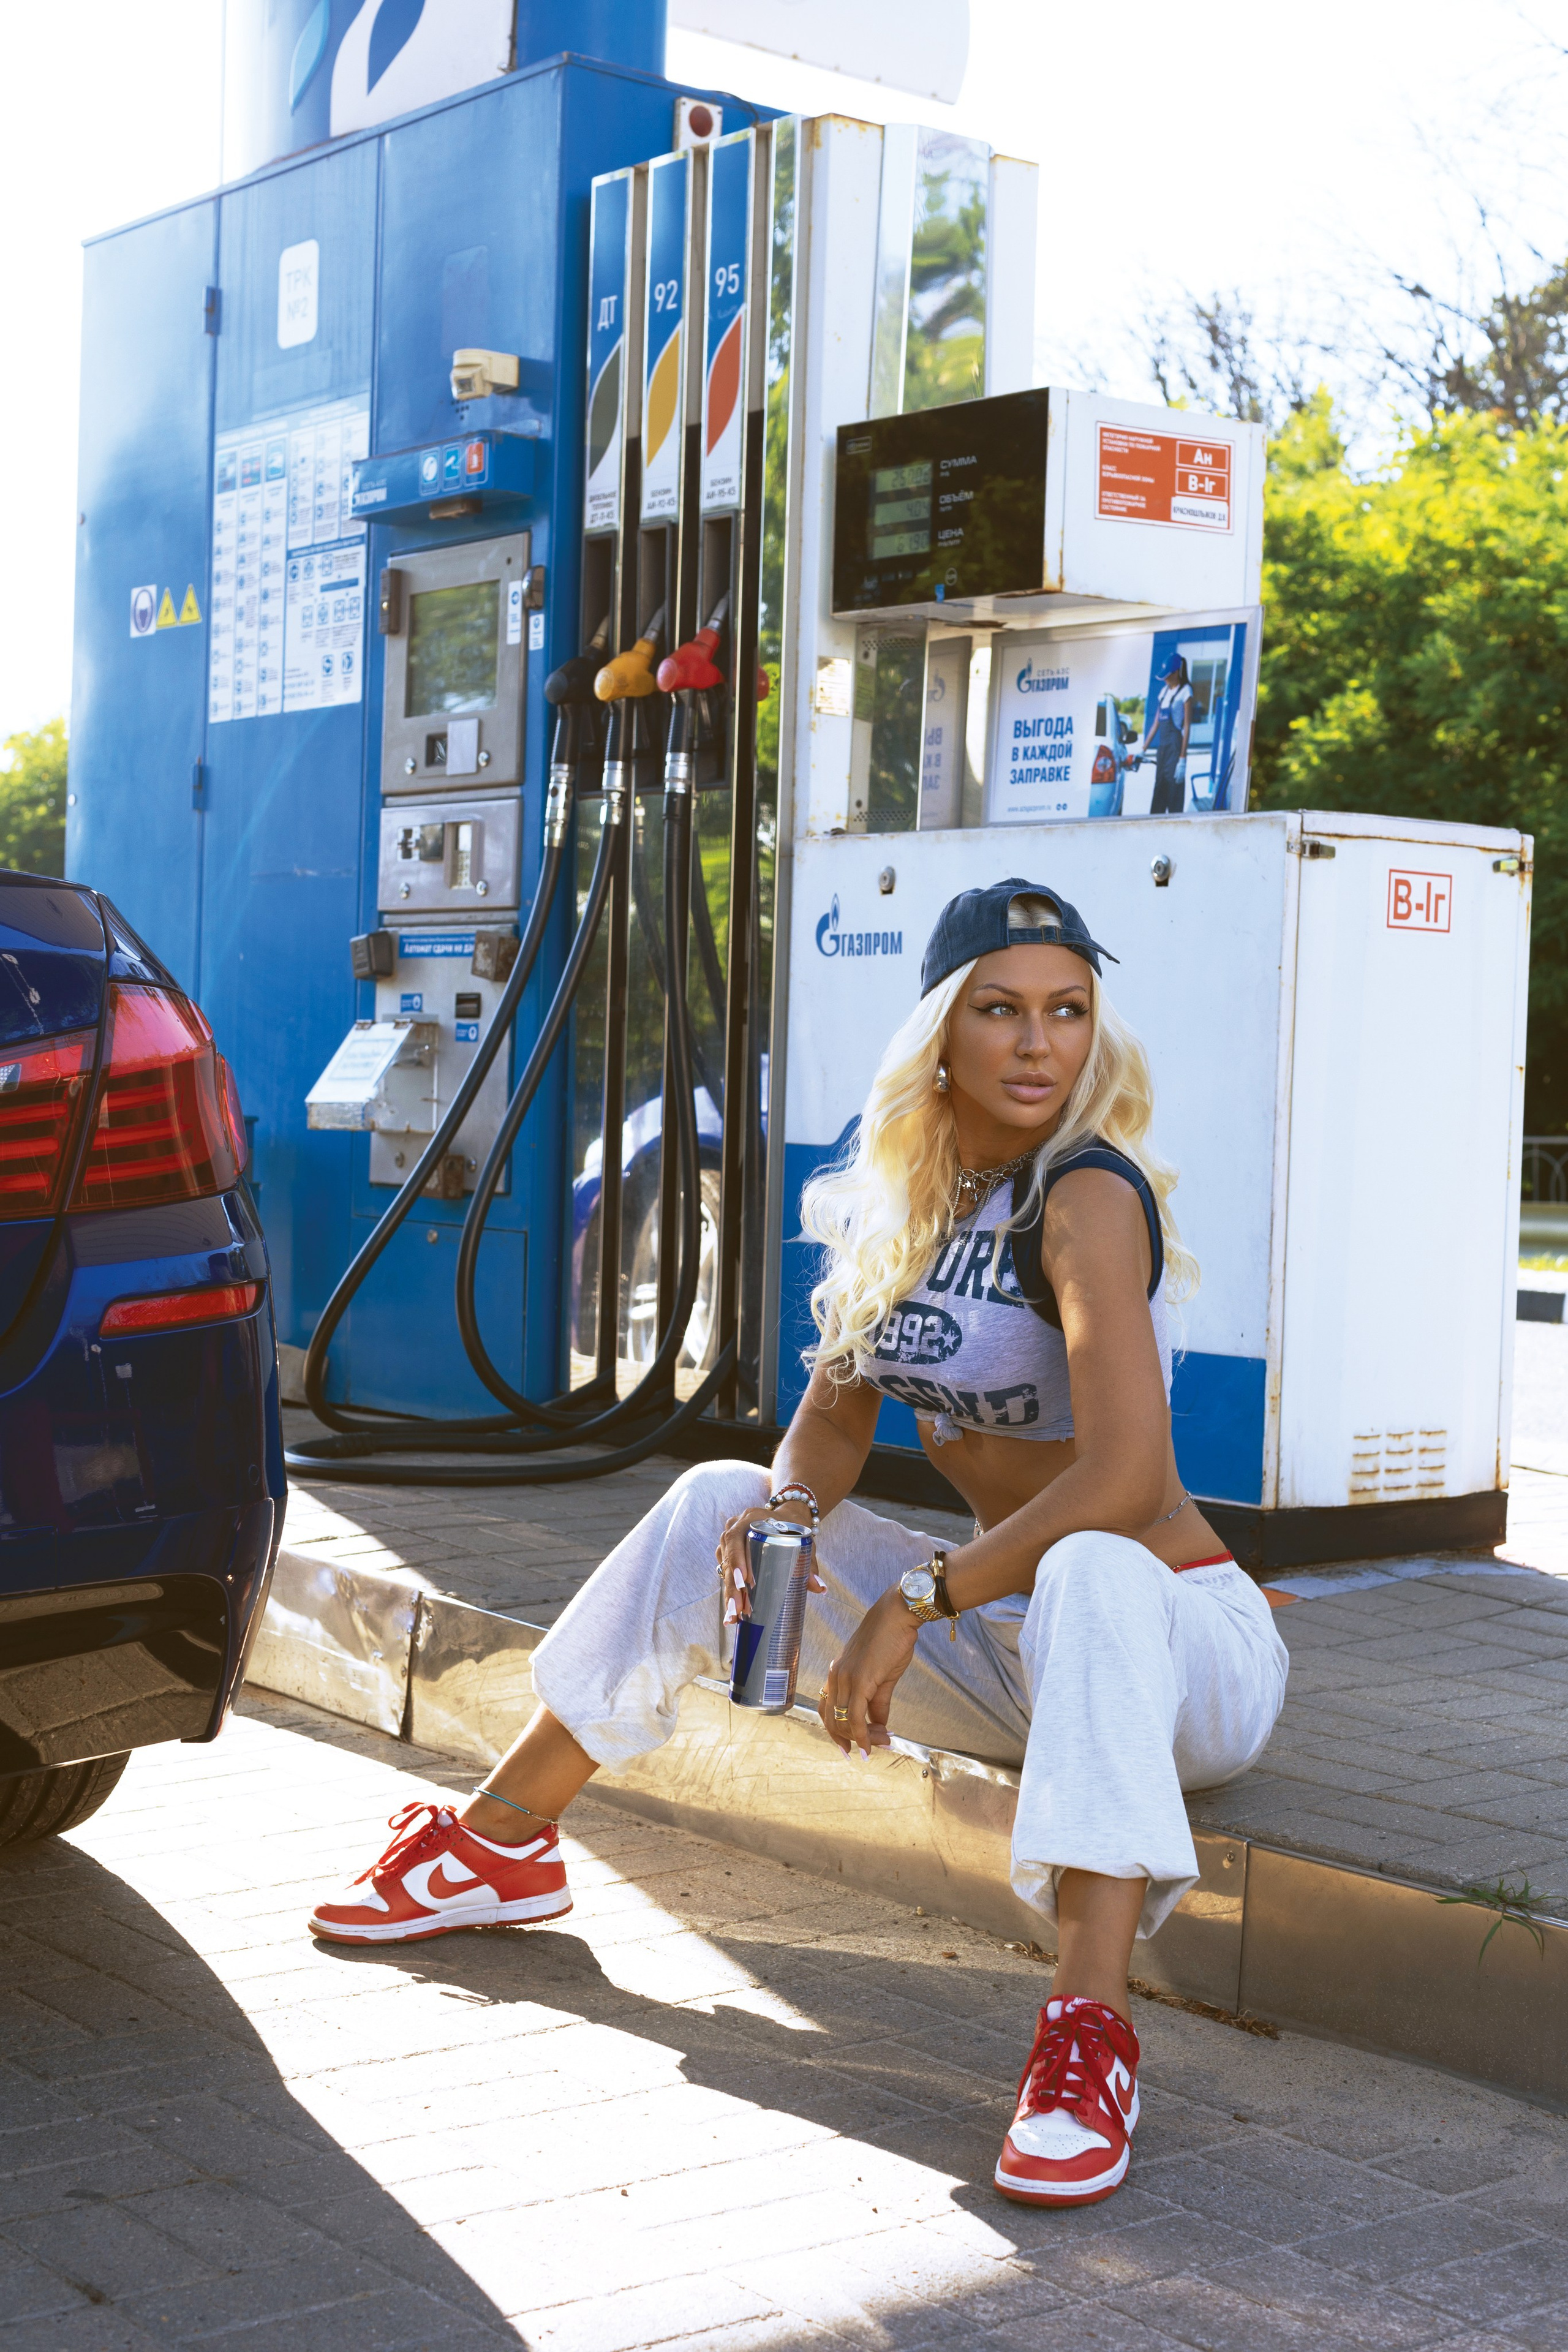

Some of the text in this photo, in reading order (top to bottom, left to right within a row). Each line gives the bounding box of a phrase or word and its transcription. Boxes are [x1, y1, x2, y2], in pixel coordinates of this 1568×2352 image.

[715, 263, 739, 298] 95
[654, 280, 678, 312] 92
[597, 295, 617, 331] ДТ
[940, 456, 978, 470] СУММА
[1193, 448, 1212, 466] Ан
[938, 527, 964, 540] ЦЕНА
[1013, 716, 1073, 740] ВЫГОДА
[1012, 741, 1072, 762] В КАЖДОЙ
[1010, 766, 1071, 785] ЗАПРАВКЕ
[841, 931, 902, 957] ГАЗПРОМ
